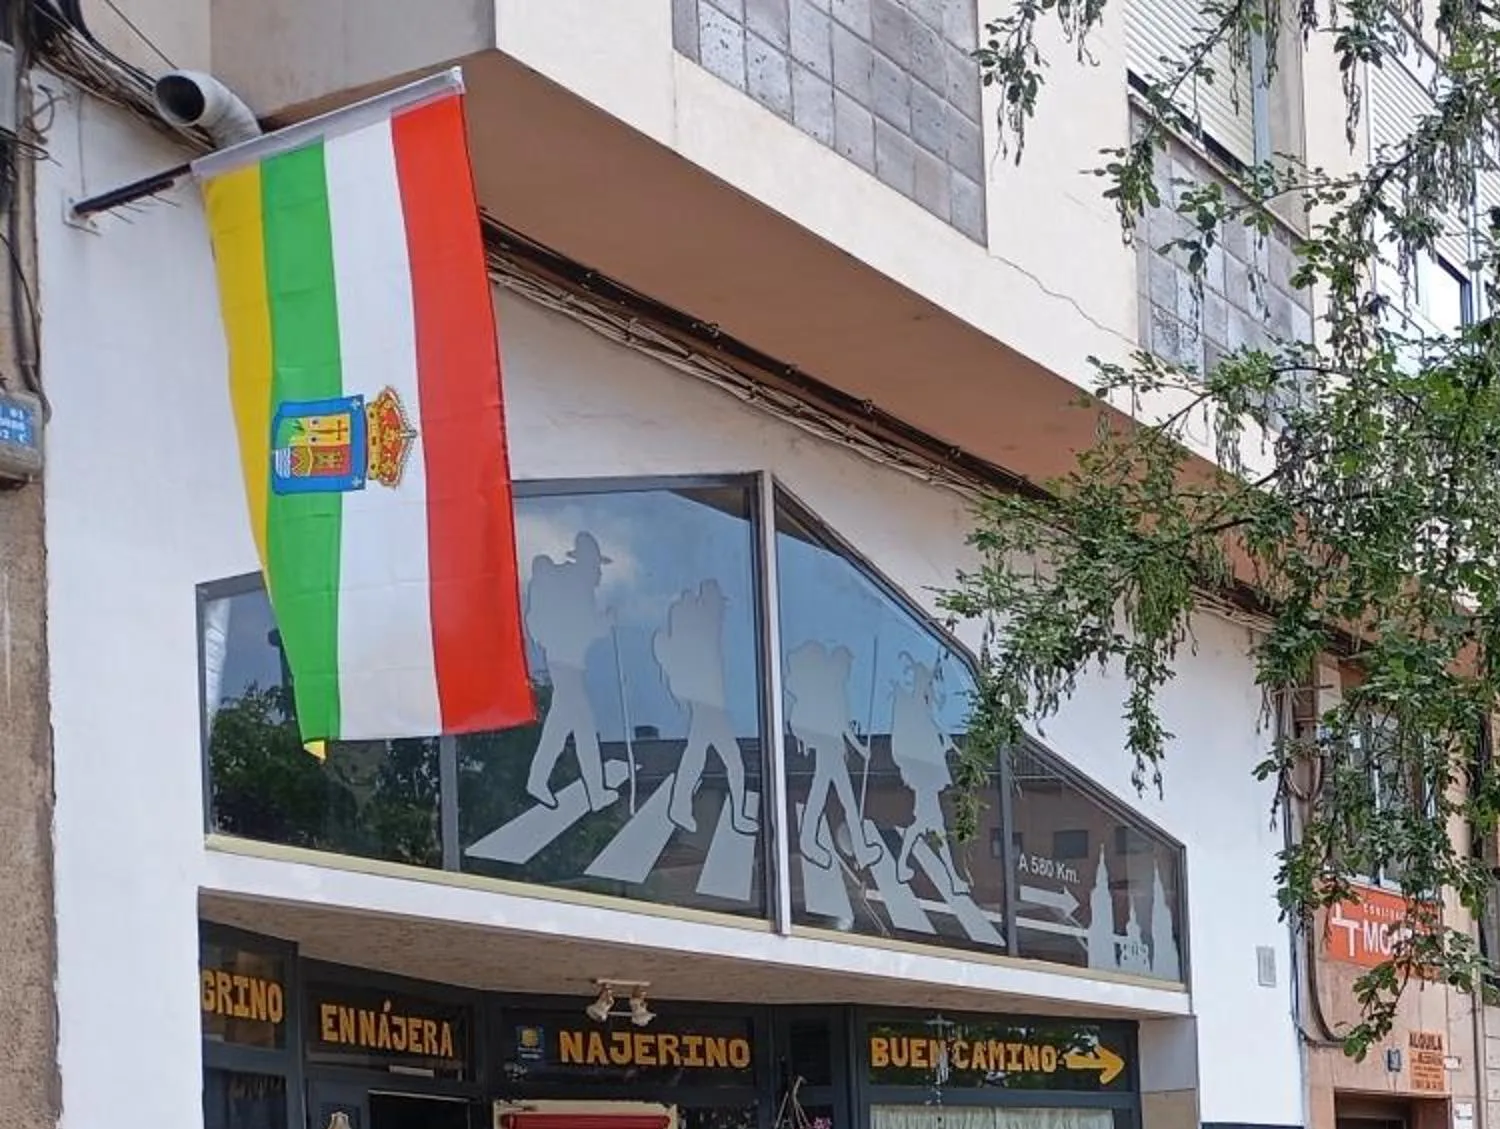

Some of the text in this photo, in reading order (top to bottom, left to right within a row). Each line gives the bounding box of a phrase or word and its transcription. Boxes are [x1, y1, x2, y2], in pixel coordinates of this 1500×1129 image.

[1018, 853, 1029, 872] A
[1031, 855, 1055, 878] 580
[321, 1001, 453, 1057] EN NÁJERA
[559, 1031, 750, 1068] NAJERINO
[870, 1037, 1057, 1073] BUEN CAMINO
